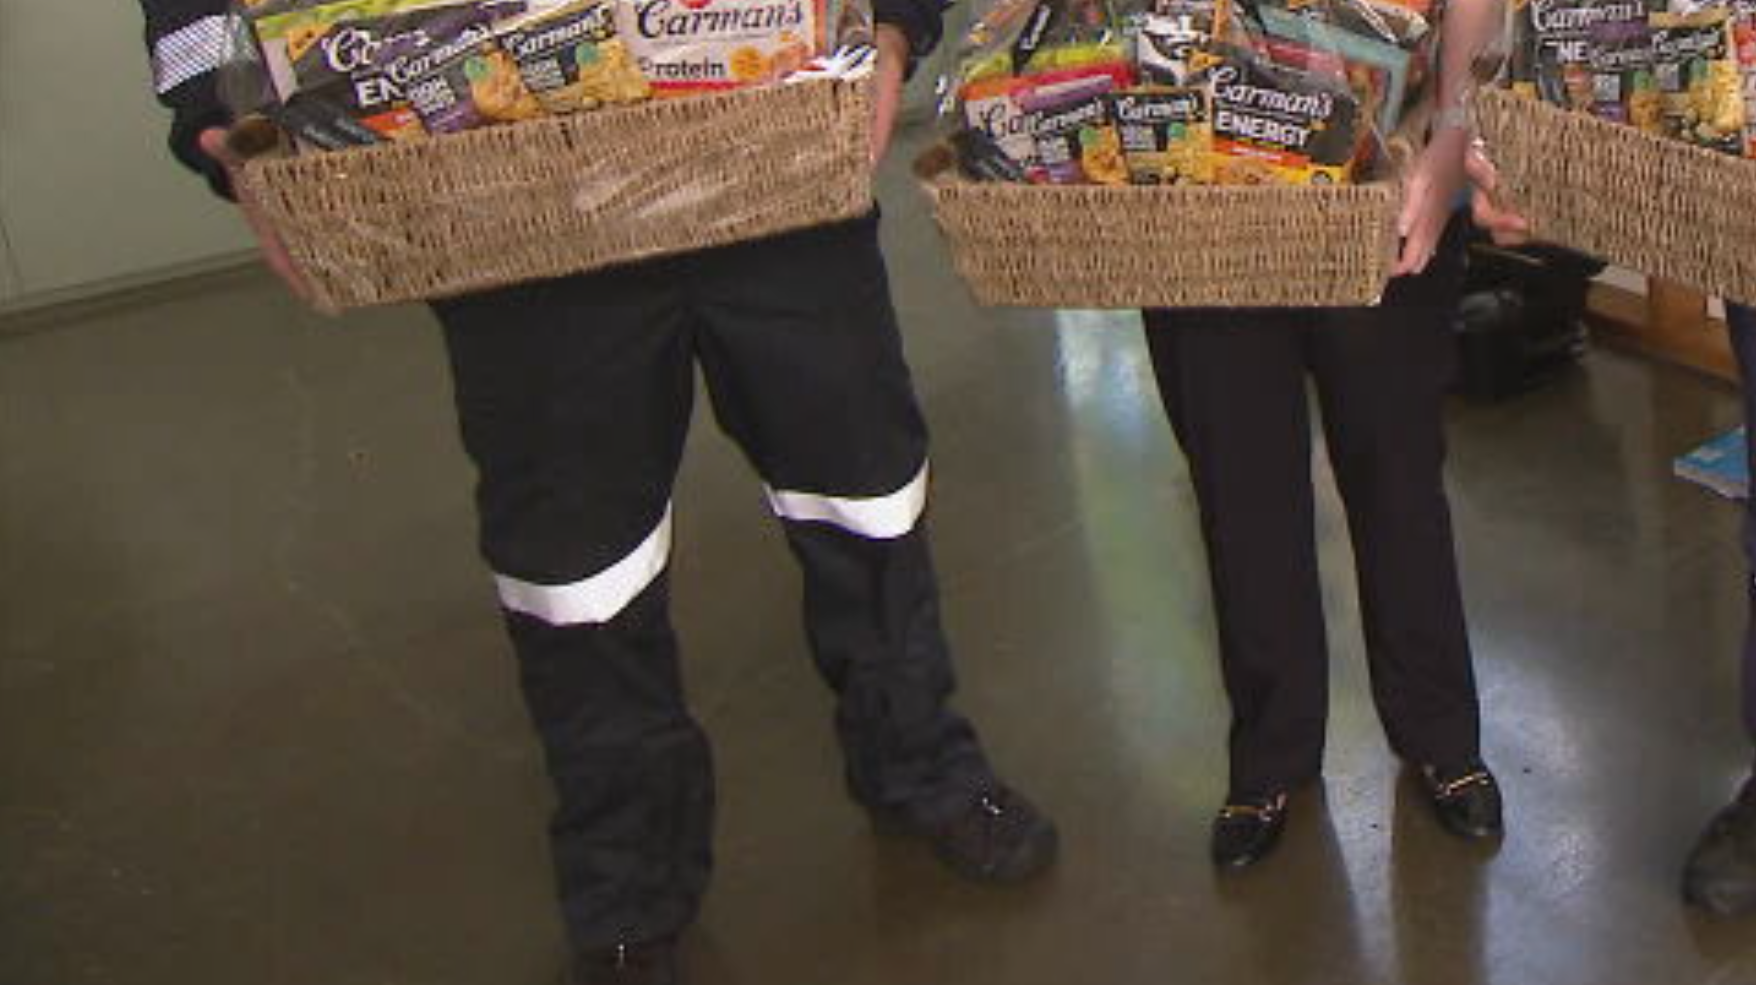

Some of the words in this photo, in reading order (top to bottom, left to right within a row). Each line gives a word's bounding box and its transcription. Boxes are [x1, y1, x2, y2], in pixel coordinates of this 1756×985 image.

[502, 12, 606, 58] Carman's
[1208, 66, 1333, 119] Carman's
[1215, 110, 1311, 147] ENERGY
